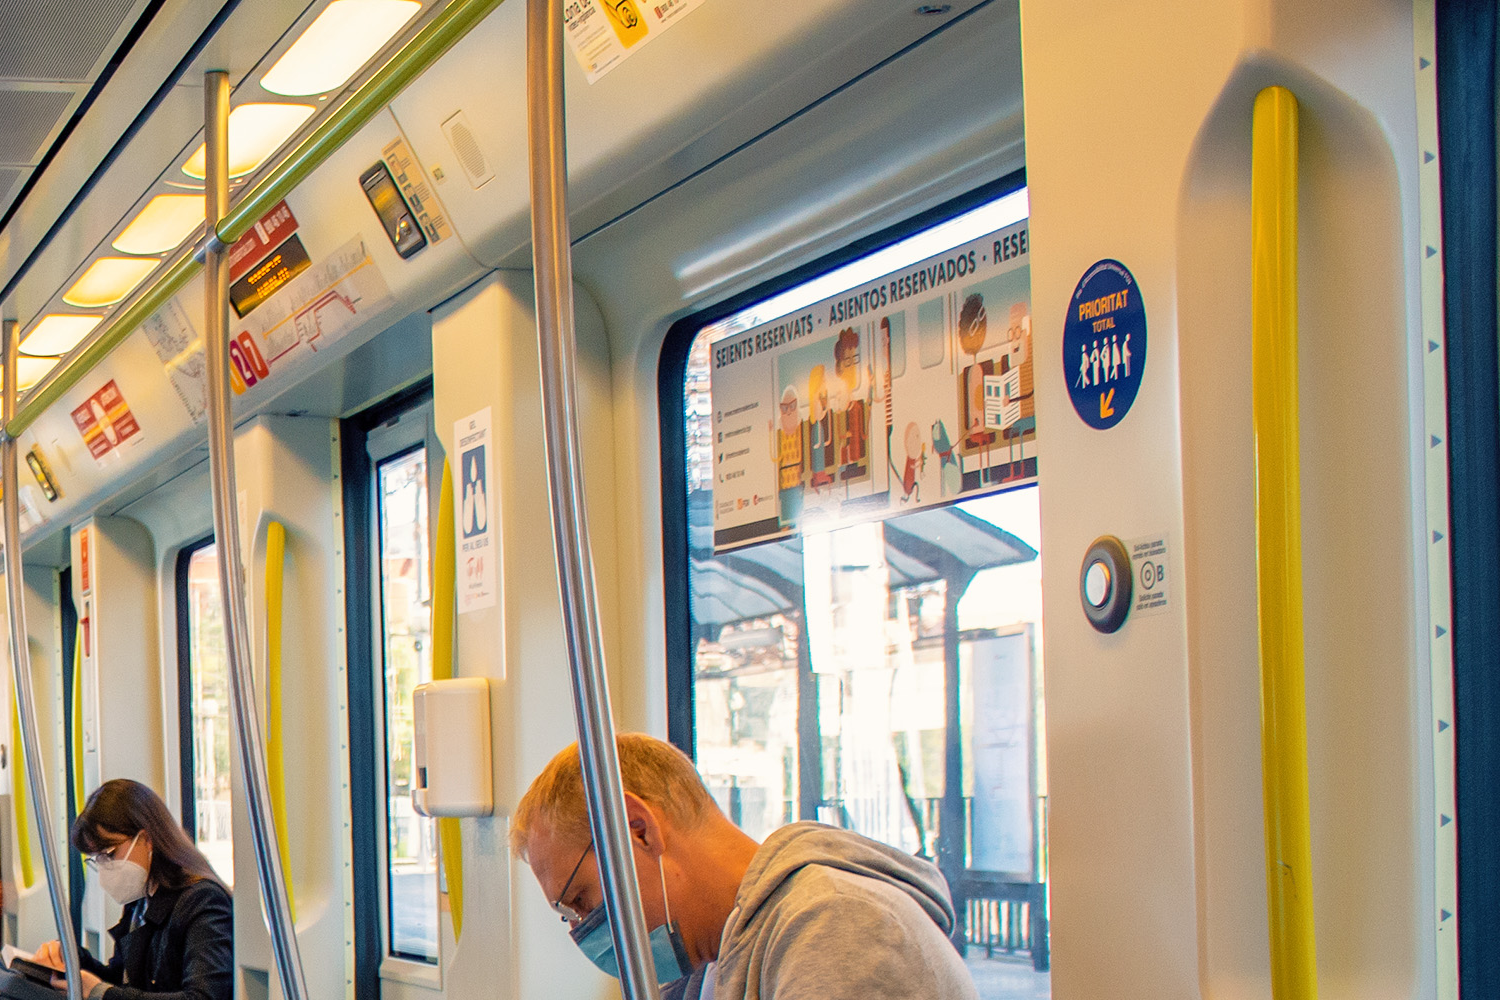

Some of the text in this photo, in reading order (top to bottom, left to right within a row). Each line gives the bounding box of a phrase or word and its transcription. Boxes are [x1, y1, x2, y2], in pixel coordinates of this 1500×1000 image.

[716, 230, 1030, 369] SEIENTS RESERVATS ASIENTOS RESERVADOS RESE
[1079, 289, 1129, 321] PRIORITAT
[1092, 317, 1116, 333] TOTAL
[231, 348, 253, 380] 2
[243, 339, 263, 372] 7
[1156, 564, 1165, 582] B
